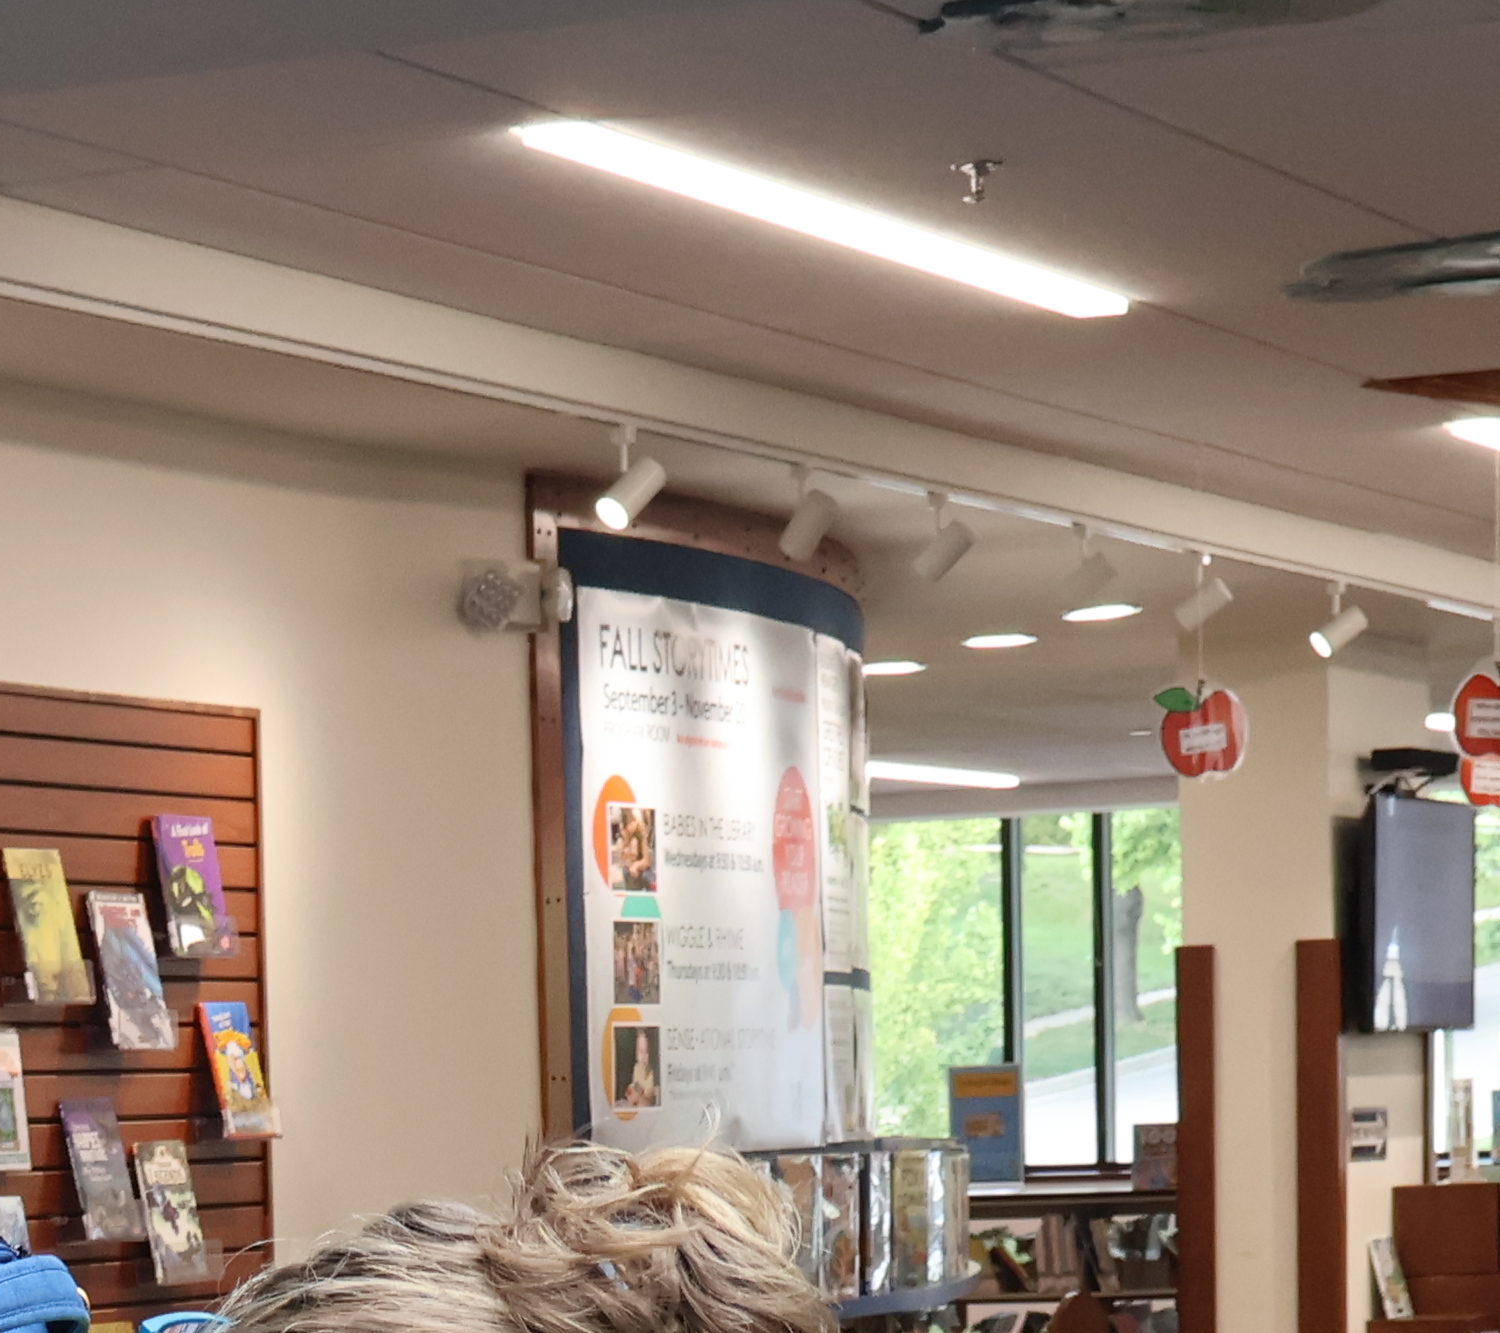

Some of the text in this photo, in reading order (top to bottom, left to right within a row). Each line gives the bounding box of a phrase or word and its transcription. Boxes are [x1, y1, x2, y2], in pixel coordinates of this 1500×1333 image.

[598, 623, 750, 687] FALL STORYTIMES
[603, 682, 670, 717] September
[684, 692, 732, 724] November
[18, 862, 52, 879] ELVES
